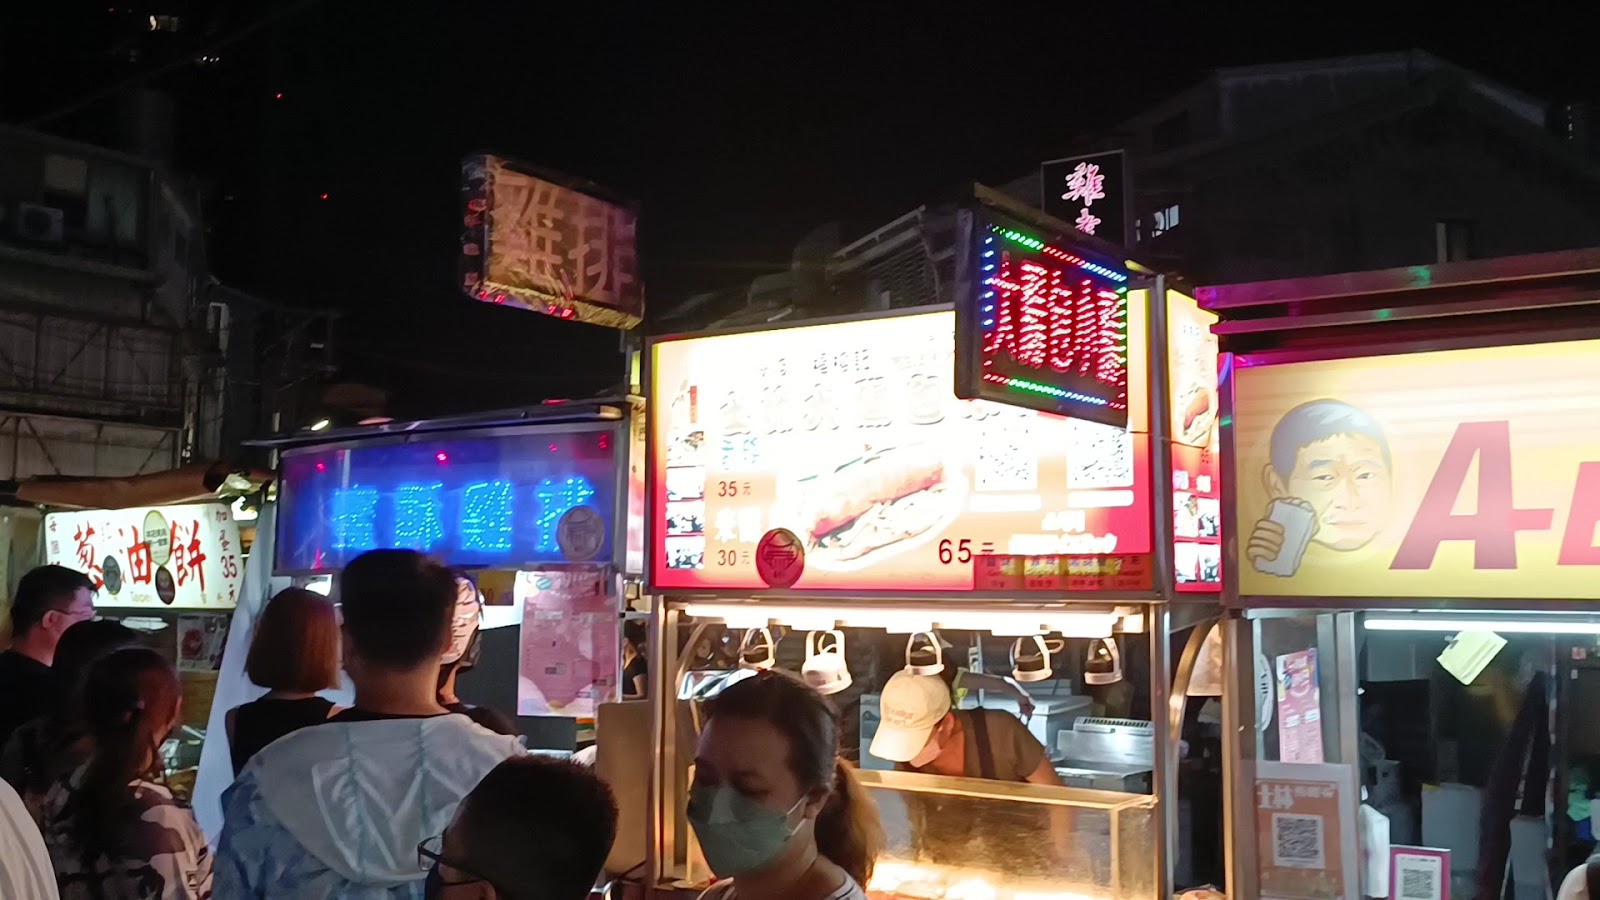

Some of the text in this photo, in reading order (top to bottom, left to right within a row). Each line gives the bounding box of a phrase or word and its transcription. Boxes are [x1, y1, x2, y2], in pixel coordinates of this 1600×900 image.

[717, 480, 738, 497] 35
[717, 549, 737, 567] 30
[938, 538, 972, 565] 65
